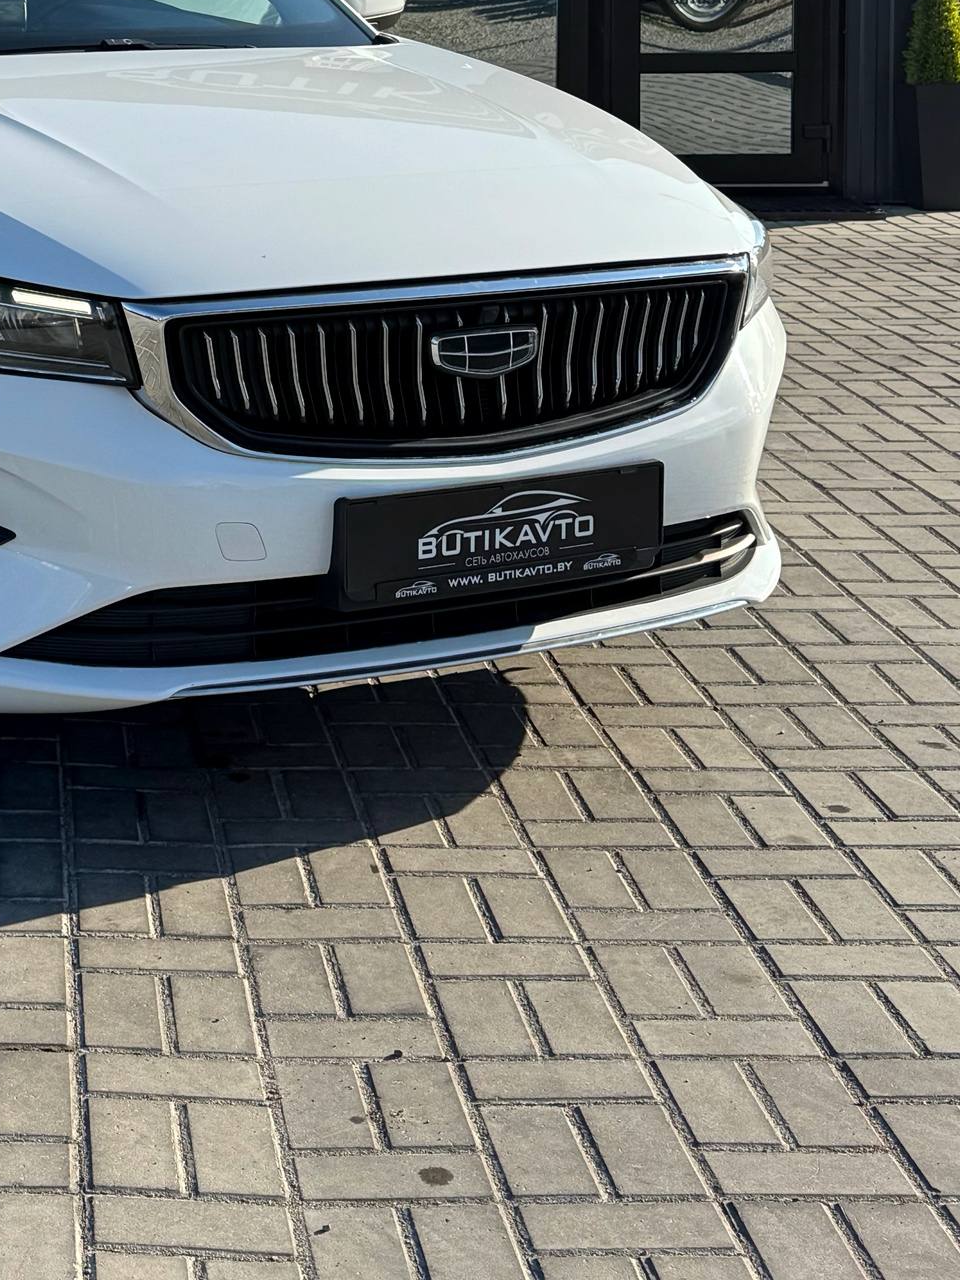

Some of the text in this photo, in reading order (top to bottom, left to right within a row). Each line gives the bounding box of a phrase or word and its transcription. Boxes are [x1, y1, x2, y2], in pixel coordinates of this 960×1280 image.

[417, 515, 594, 560] BUTIKAVTO
[465, 547, 550, 567] СЕТЬ АВТОХАУСОВ
[583, 558, 622, 570] BUTIKAVTO
[448, 561, 573, 588] WWW. BUTIKAVTO.BY
[395, 586, 437, 598] BUTIKAVTO
